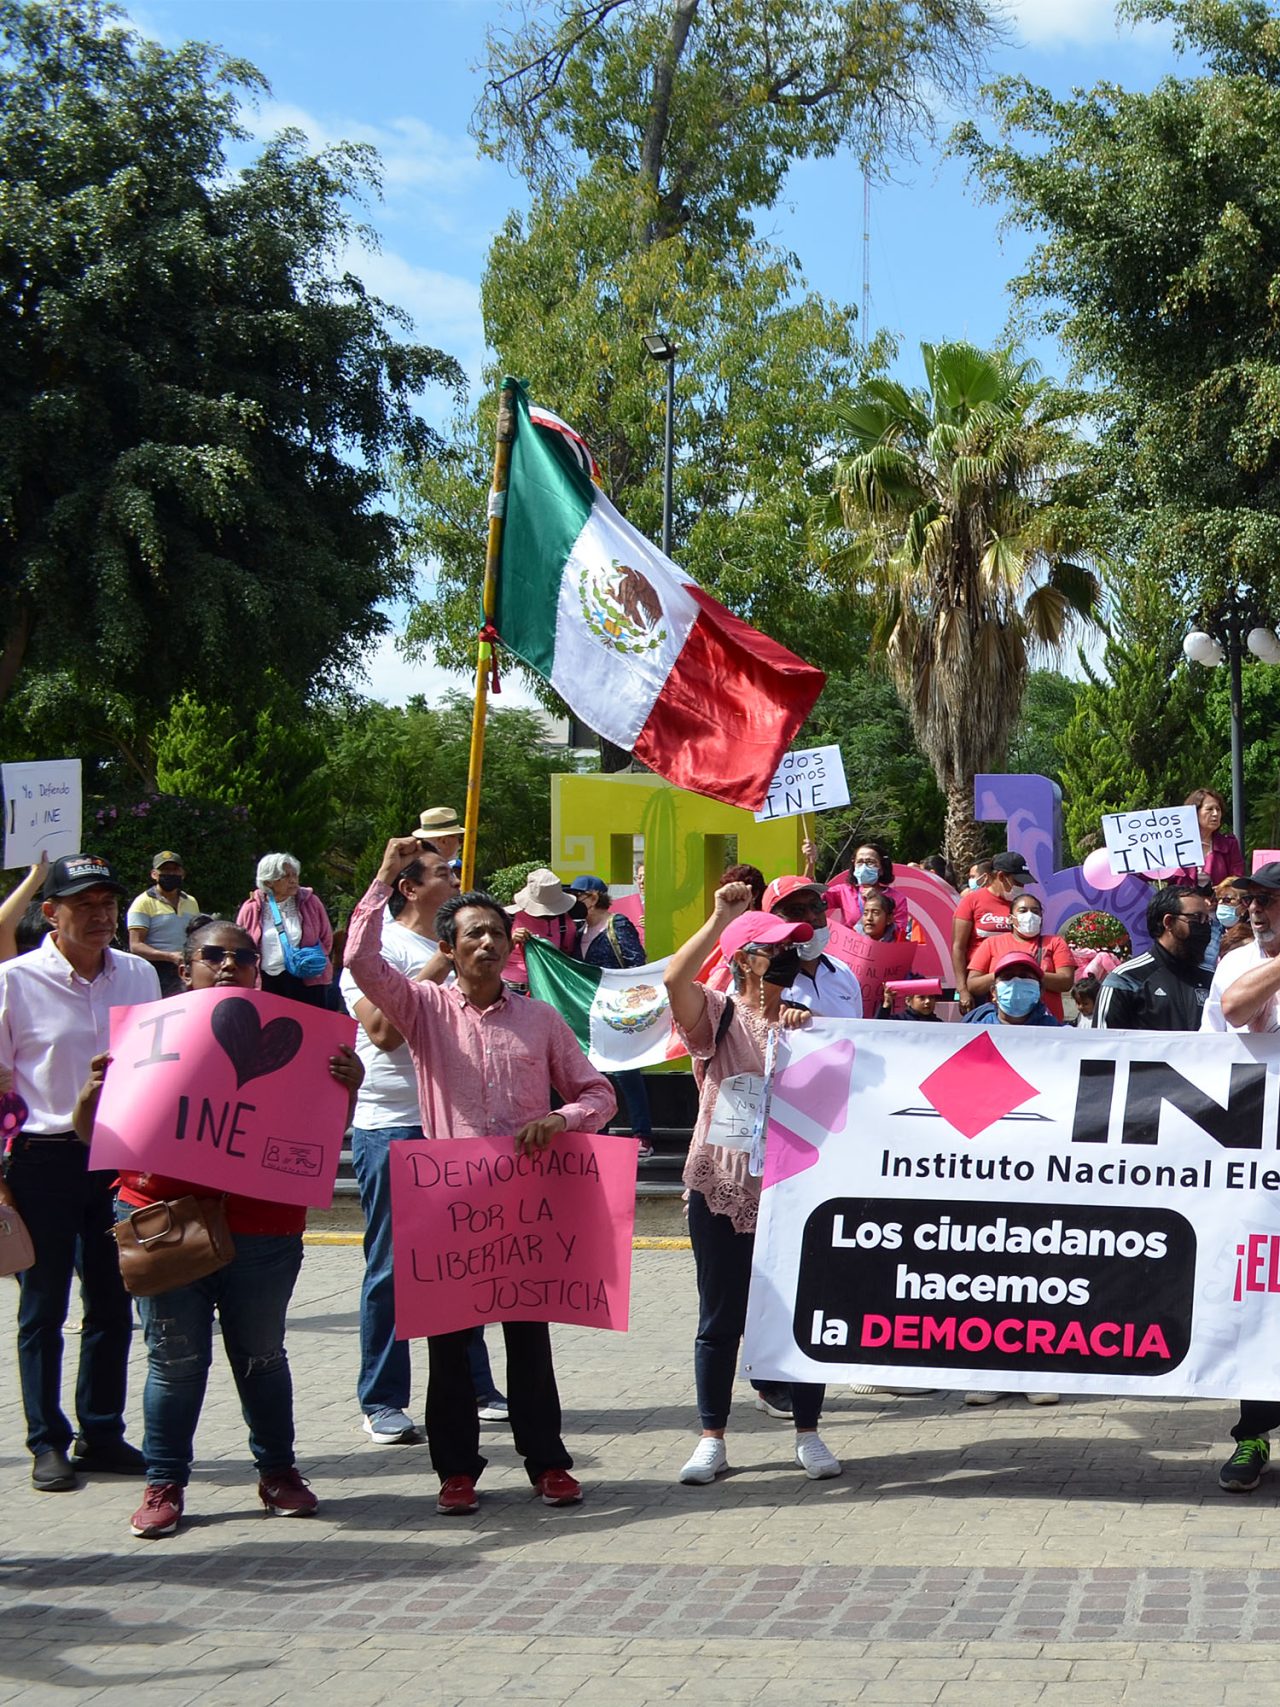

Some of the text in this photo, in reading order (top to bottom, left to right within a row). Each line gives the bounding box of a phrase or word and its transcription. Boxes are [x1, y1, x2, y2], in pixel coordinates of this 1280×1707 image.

[22, 782, 71, 799] Yo Defiendo
[764, 783, 827, 820] INE
[44, 808, 61, 824] INE
[1110, 810, 1181, 834] Todos
[1113, 840, 1197, 874] INE
[1127, 828, 1184, 846] somos
[175, 1094, 256, 1158] INE
[406, 1148, 600, 1188] DEMOCRACIA
[880, 1149, 1036, 1182] Instituto
[1046, 1154, 1212, 1189] Nacional
[447, 1197, 554, 1233] POR LA
[831, 1214, 1168, 1259] Los ciudadanos
[411, 1231, 576, 1283] LIBERTAR Y
[471, 1275, 611, 1317] JUSTICIA
[895, 1263, 1091, 1306] hacemos
[810, 1310, 1172, 1359] la DEMOCRACIA
